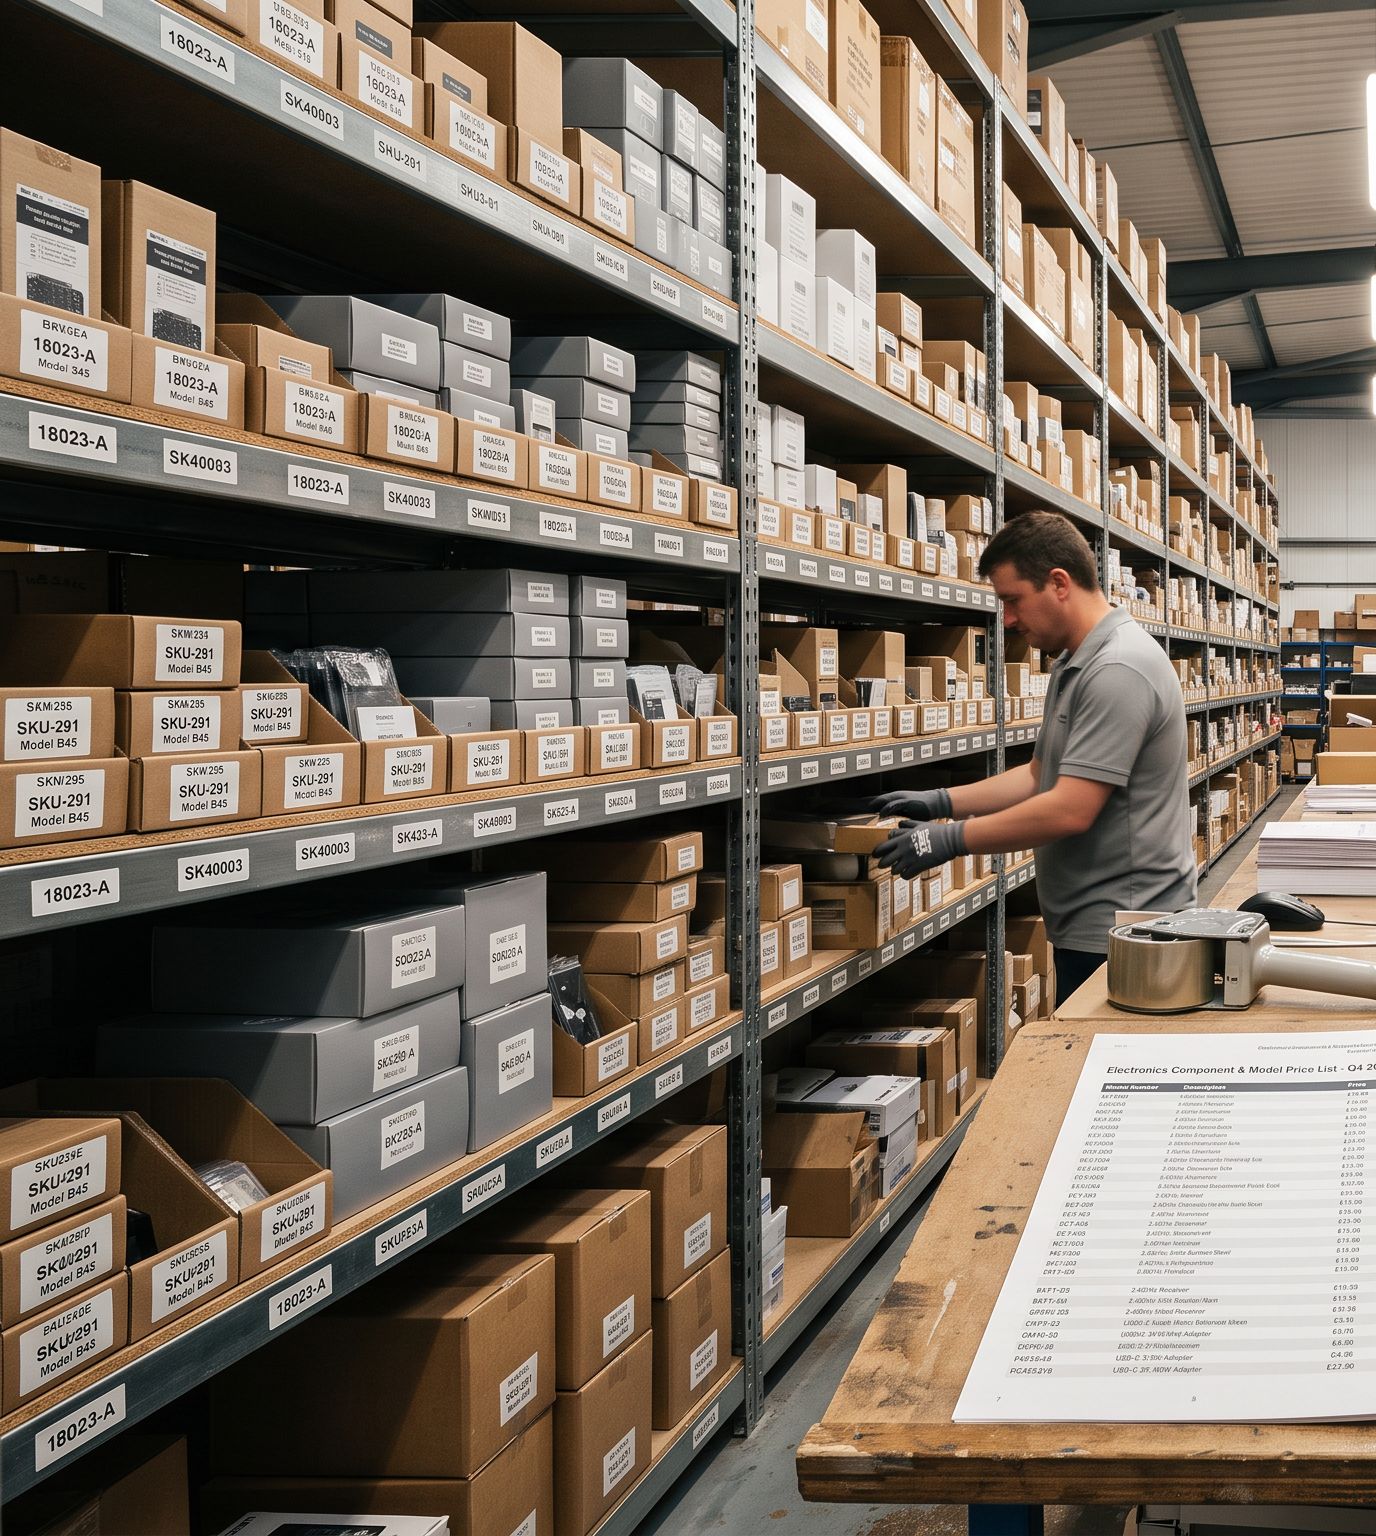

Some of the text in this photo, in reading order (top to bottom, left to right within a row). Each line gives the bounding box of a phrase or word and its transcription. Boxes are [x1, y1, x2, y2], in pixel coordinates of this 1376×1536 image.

[169, 30, 228, 72] 18023-A
[33, 337, 96, 364] 18023-A
[38, 358, 90, 378] Model 345
[166, 371, 218, 395] 18023-A
[38, 424, 108, 451] 18023-A
[293, 475, 343, 495] 18023-A
[196, 664, 212, 673] B45
[251, 708, 292, 719] SKU-291
[17, 719, 79, 736] SKU-291
[161, 717, 210, 729] SKU-291
[20, 738, 77, 750] Model B45
[164, 734, 189, 744] Model
[292, 772, 334, 787] SKU-291
[391, 765, 426, 776] SKU-291
[179, 783, 229, 798] SKU-291
[28, 793, 91, 811] SKU-291
[182, 799, 228, 812] Model B45
[31, 812, 89, 827] Model B45
[301, 842, 350, 860] SK40003
[185, 859, 242, 881] SK40003
[44, 880, 110, 903] 18023-A
[1106, 1065, 1168, 1075] Electronics
[1171, 1066, 1235, 1076] Component
[1285, 1065, 1314, 1073] Price
[1317, 1065, 1337, 1073] List
[1348, 1064, 1363, 1072] Q4
[30, 1192, 64, 1215] Model
[40, 1274, 73, 1297] Model
[277, 1277, 326, 1317] 18023-A
[40, 1351, 73, 1378] Model
[48, 1402, 115, 1453] 18023-A
